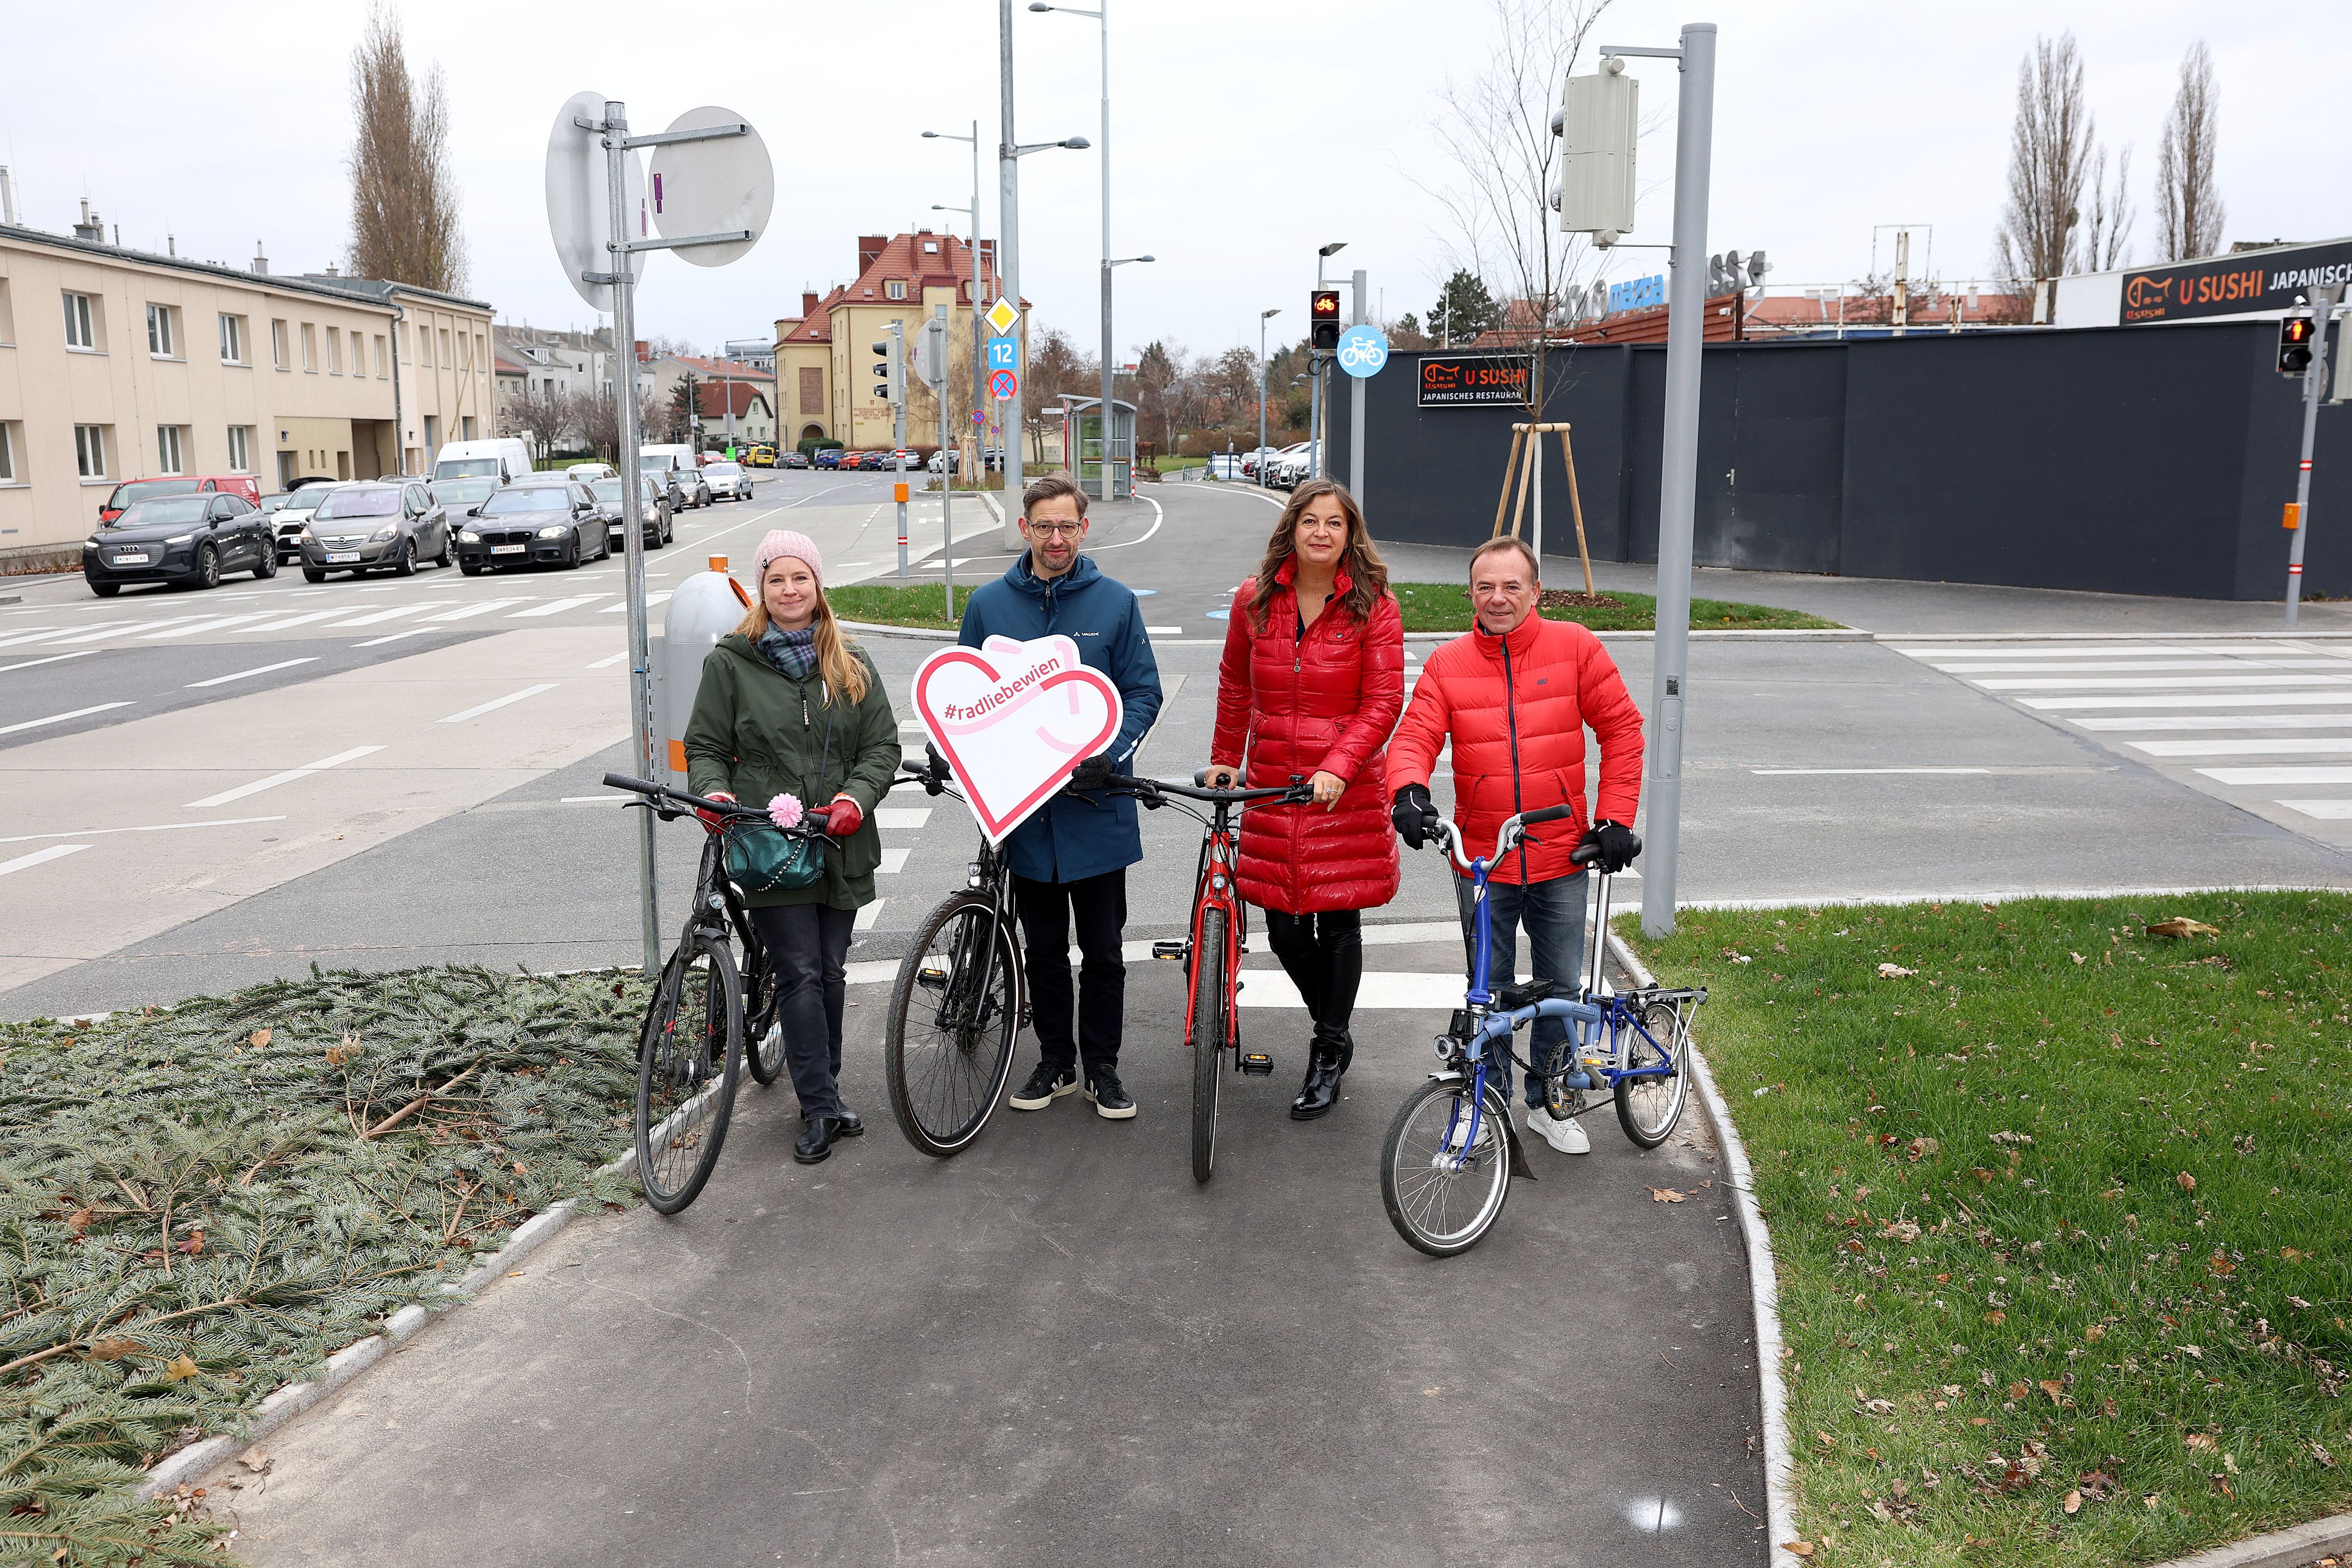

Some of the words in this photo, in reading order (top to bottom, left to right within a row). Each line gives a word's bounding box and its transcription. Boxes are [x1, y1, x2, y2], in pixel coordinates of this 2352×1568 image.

[2179, 278, 2194, 305] U
[2197, 269, 2264, 303] SUSHI
[993, 344, 1012, 363] 12
[1465, 370, 1475, 385] U
[1479, 368, 1527, 385] SUSHI
[1422, 392, 1474, 400] JAPANISCHES
[1476, 391, 1522, 400] RESTAURAN
[944, 658, 1060, 720] #radliebewien
[696, 795, 717, 805] OXYGEN
